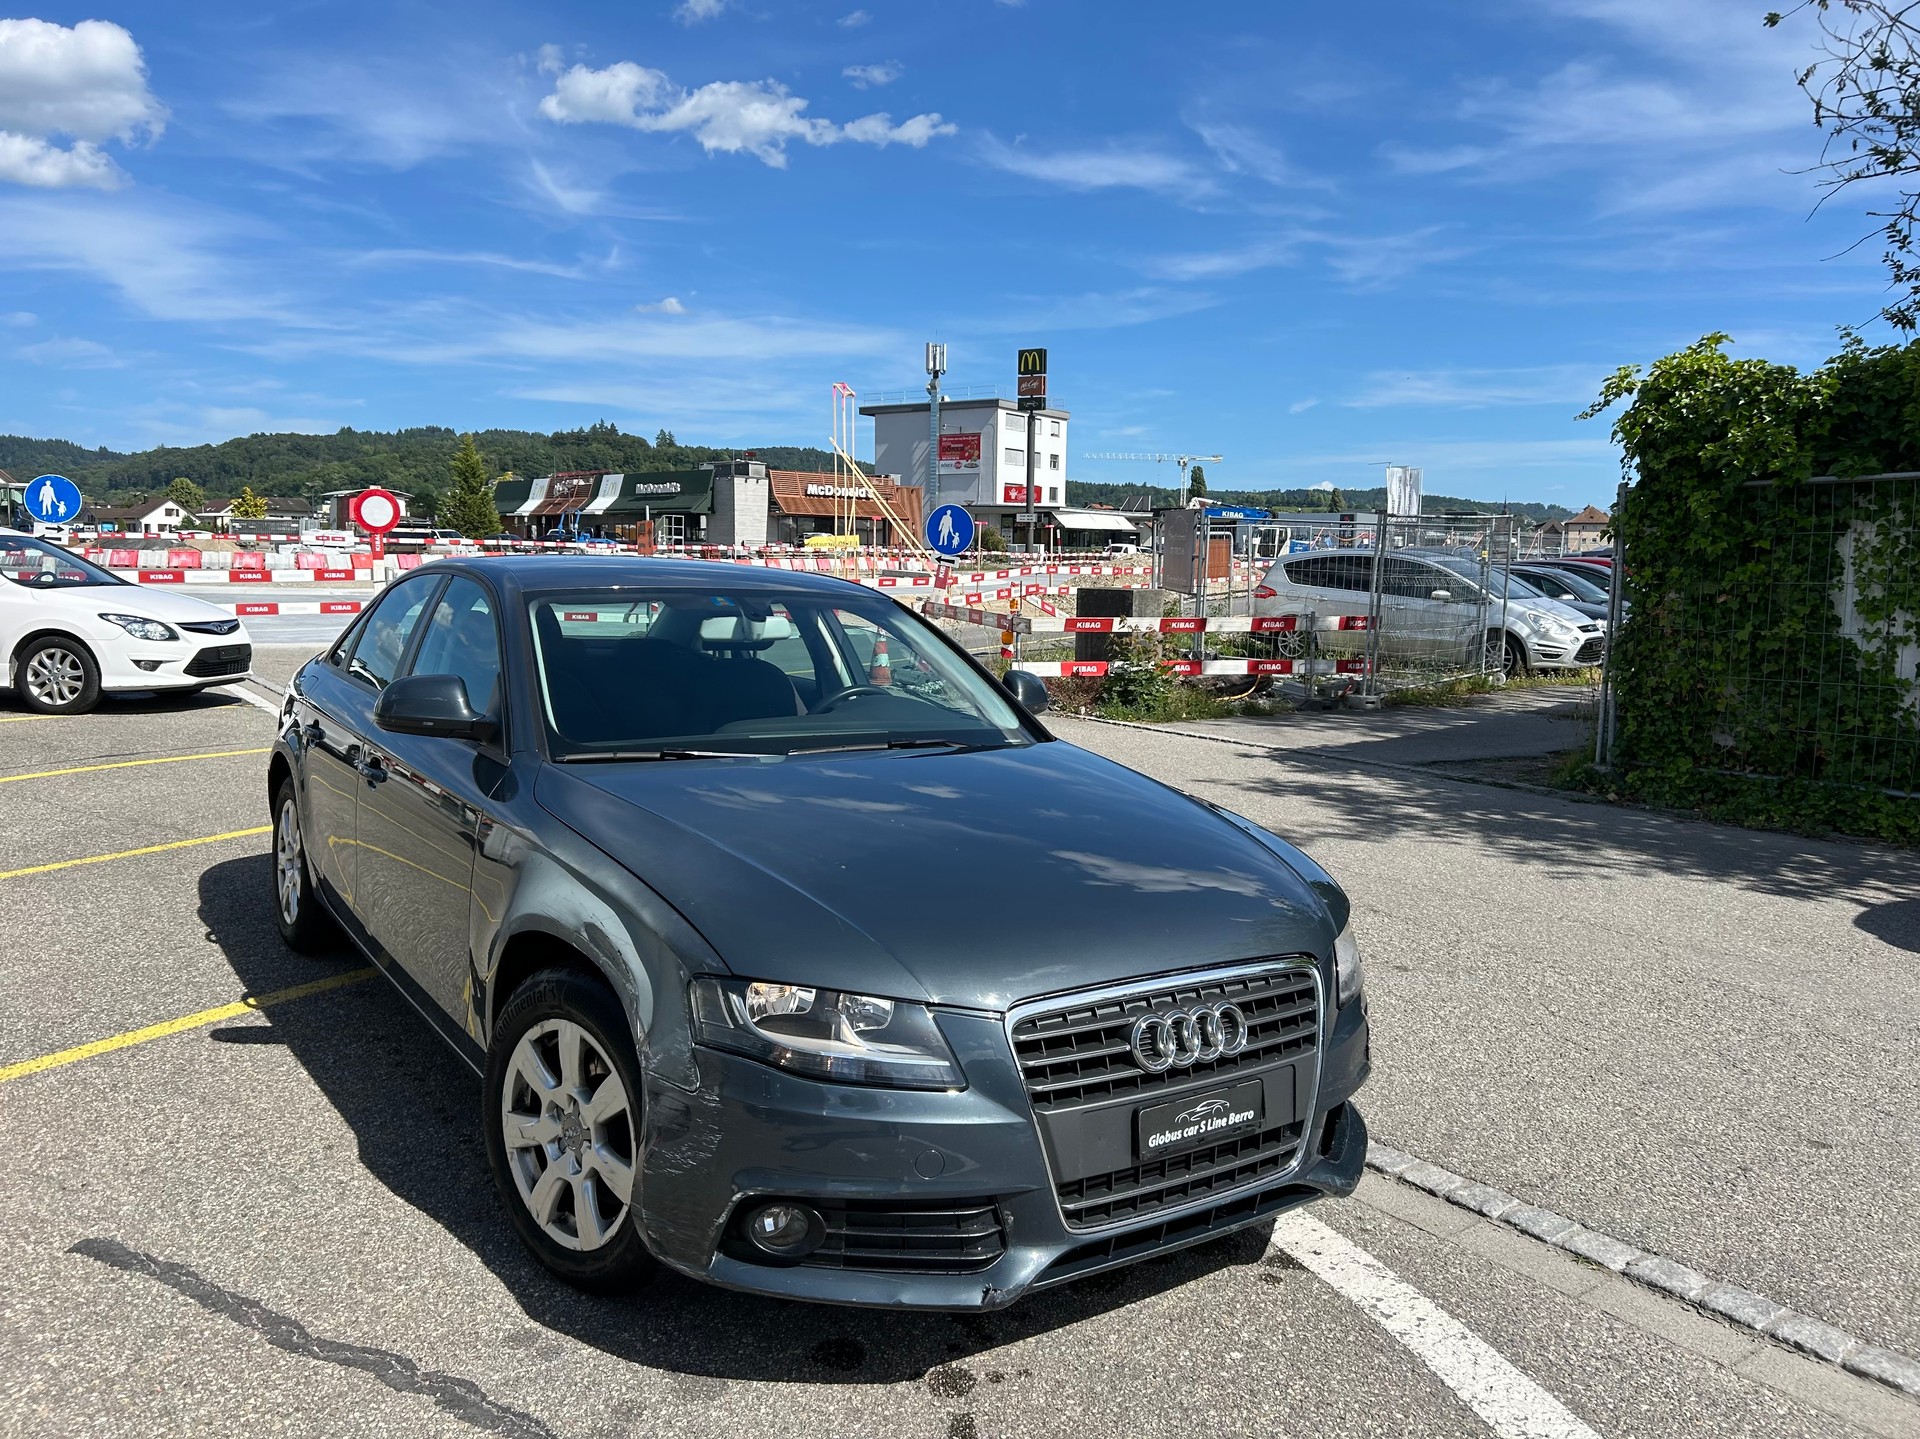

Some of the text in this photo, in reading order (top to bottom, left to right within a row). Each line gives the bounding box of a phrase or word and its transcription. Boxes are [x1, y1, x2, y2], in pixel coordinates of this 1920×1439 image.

[635, 481, 681, 495] McDonald's
[1221, 510, 1244, 518] KIBAG
[1076, 621, 1101, 629] KIBAG
[1171, 621, 1195, 629] KIBAG
[1148, 1109, 1255, 1147] Globus car S Line Berro
